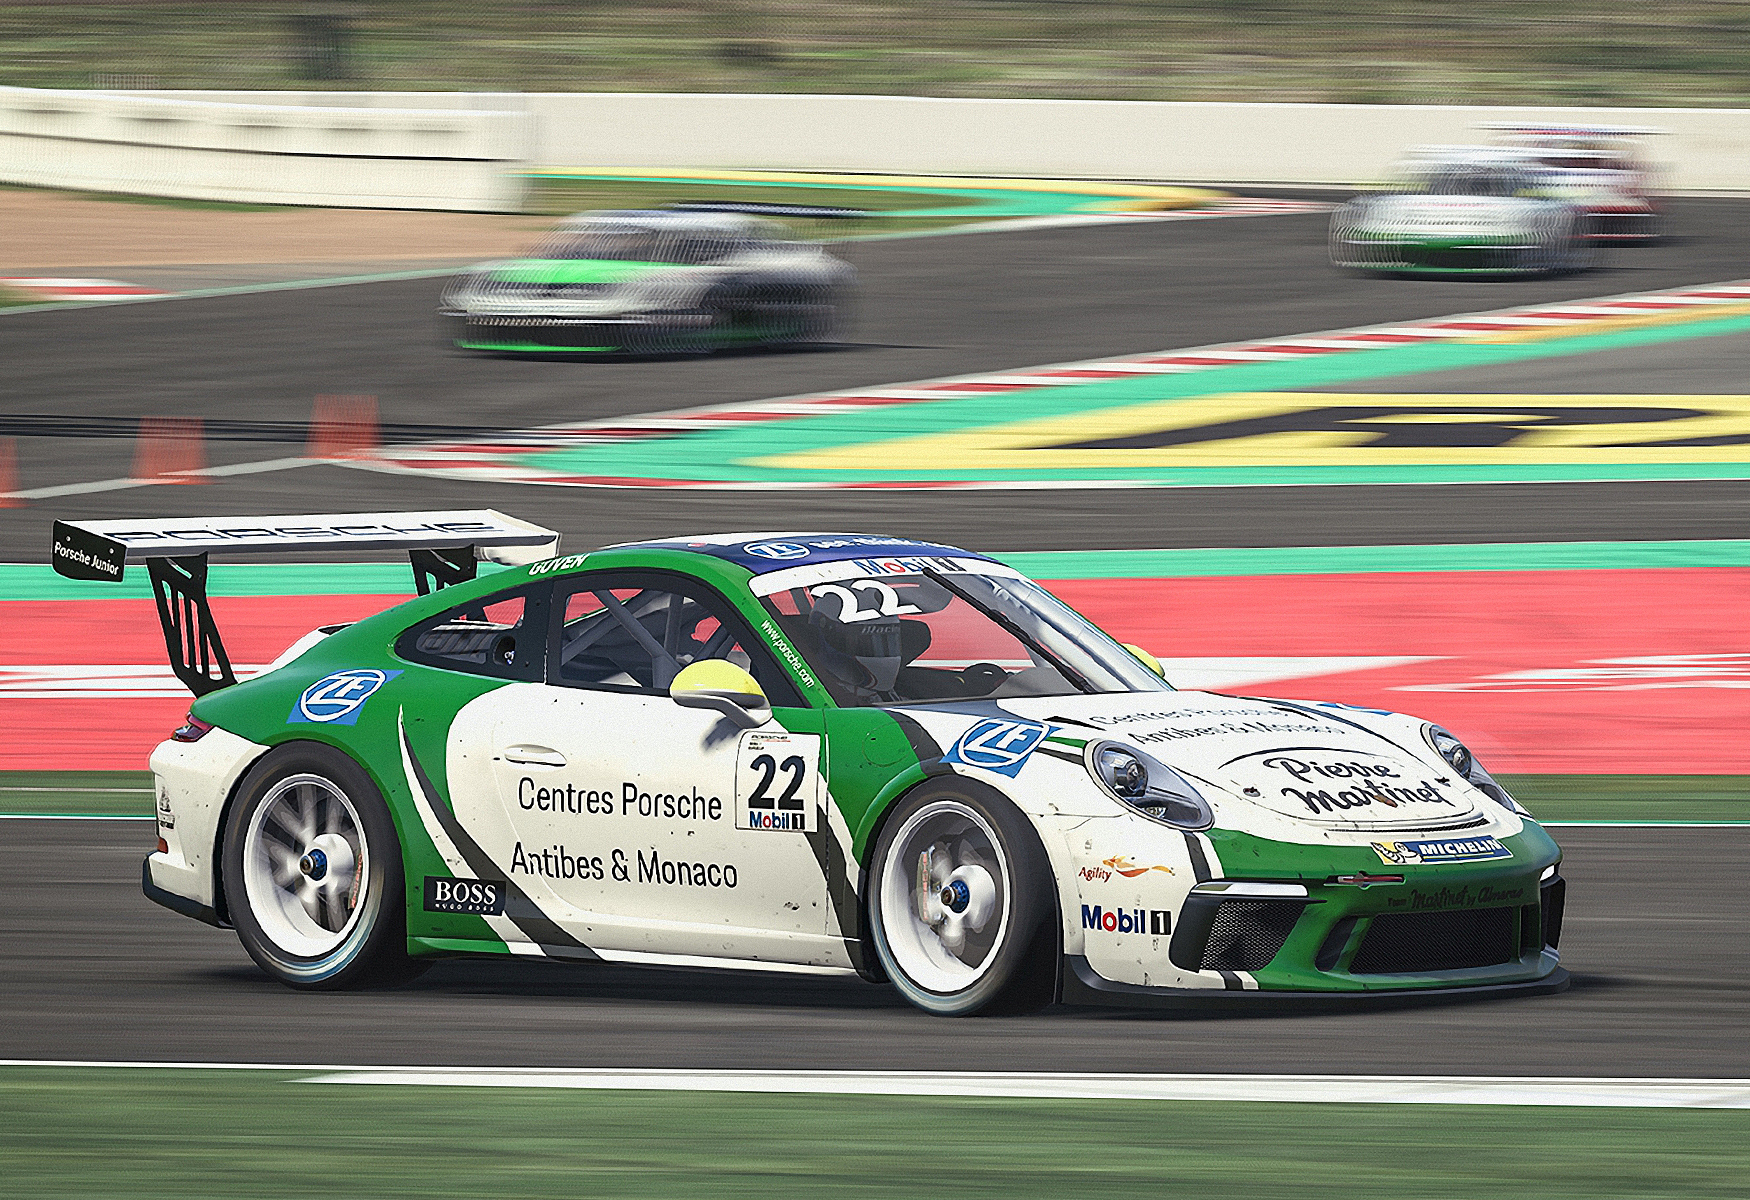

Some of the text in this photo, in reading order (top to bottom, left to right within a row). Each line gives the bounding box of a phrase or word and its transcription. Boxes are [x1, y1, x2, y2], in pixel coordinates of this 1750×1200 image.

[103, 522, 503, 541] PORSCHE
[54, 541, 119, 576] Porsche Junior
[853, 558, 940, 575] Mobil
[810, 579, 923, 624] 22
[760, 619, 815, 689] www.porsche.com
[302, 671, 383, 712] ZF
[961, 720, 1046, 760] ZF
[748, 754, 806, 811] 22
[1262, 757, 1400, 784] Pierre
[518, 777, 723, 820] Centres Porsche
[1281, 779, 1456, 814] Martinet
[749, 811, 790, 830] Mobil
[1418, 838, 1502, 855] MICHELIN
[510, 842, 738, 889] Antibes & Monaco
[1078, 866, 1112, 883] Agility
[435, 880, 496, 905] BOSS
[1081, 904, 1146, 934] Mobil
